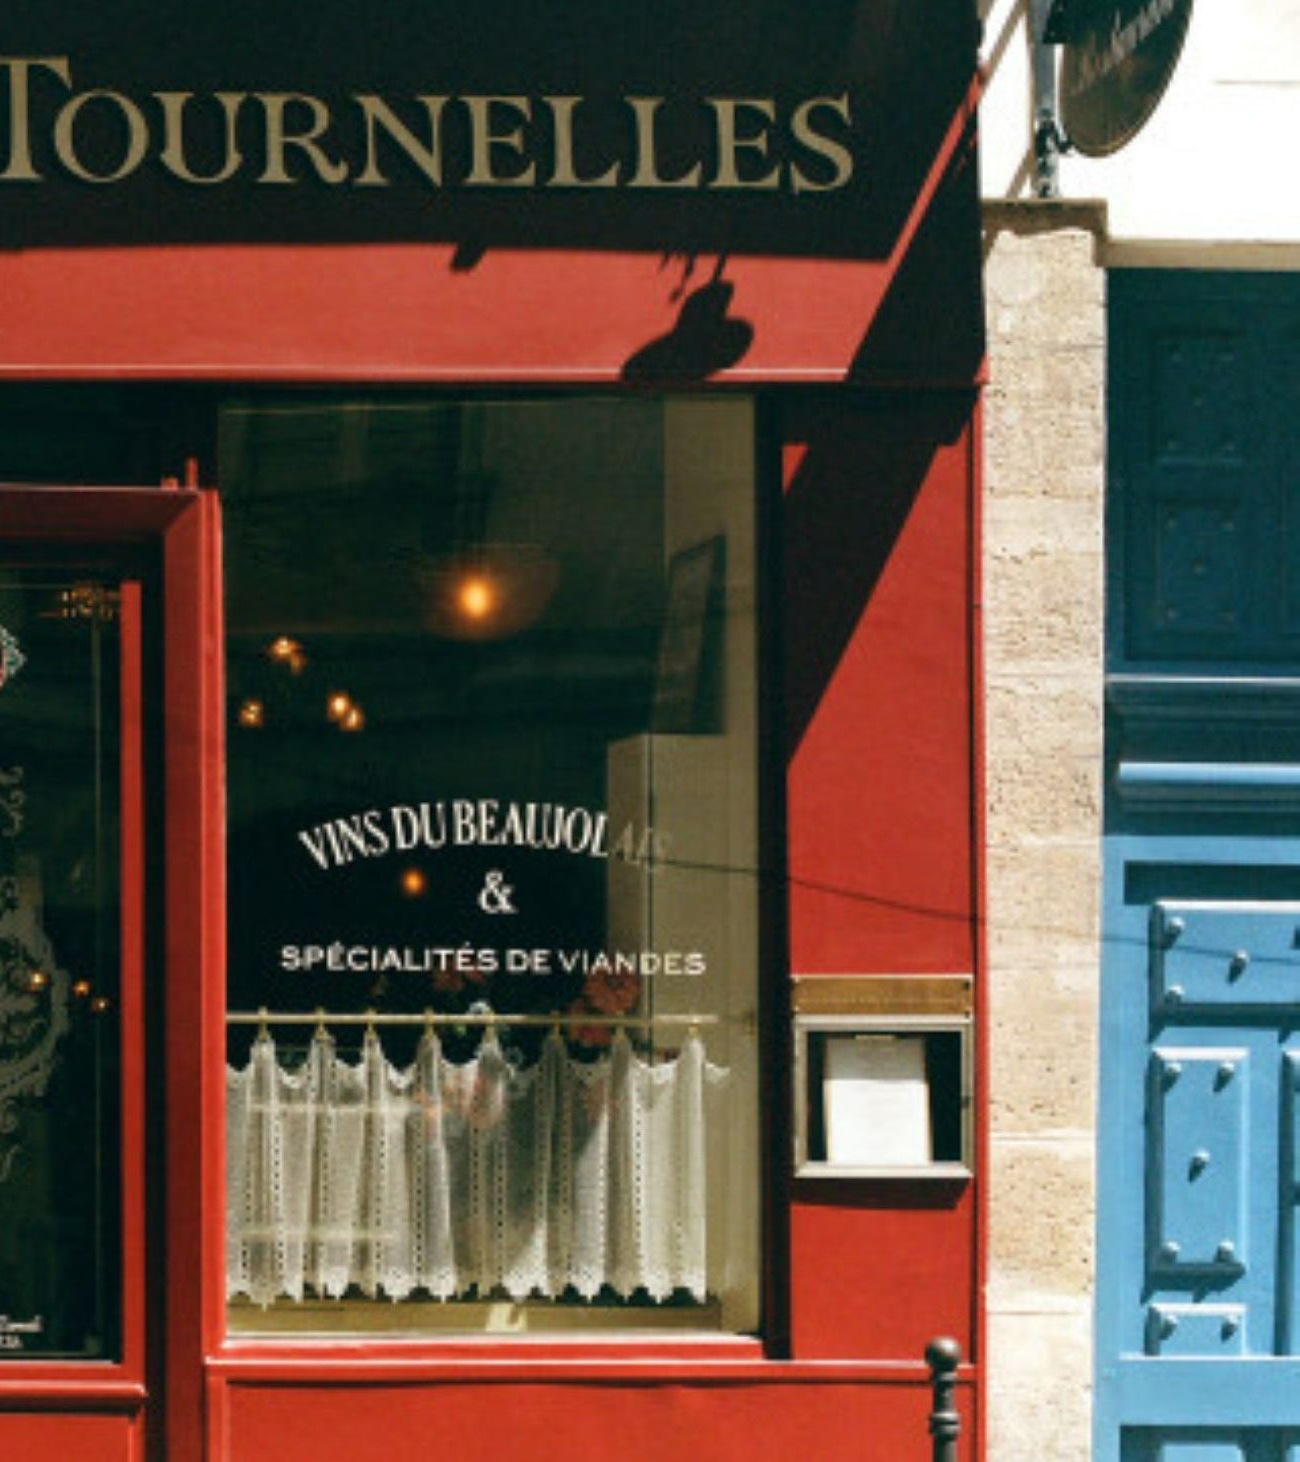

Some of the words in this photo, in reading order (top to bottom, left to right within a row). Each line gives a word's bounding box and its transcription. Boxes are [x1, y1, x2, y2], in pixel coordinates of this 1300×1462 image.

[299, 810, 389, 869] VINS
[391, 802, 447, 851] DU
[477, 870, 518, 914] &
[281, 940, 499, 972] SPÉCIALITÉS
[506, 947, 551, 973] DE
[558, 950, 706, 976] VIANDES
